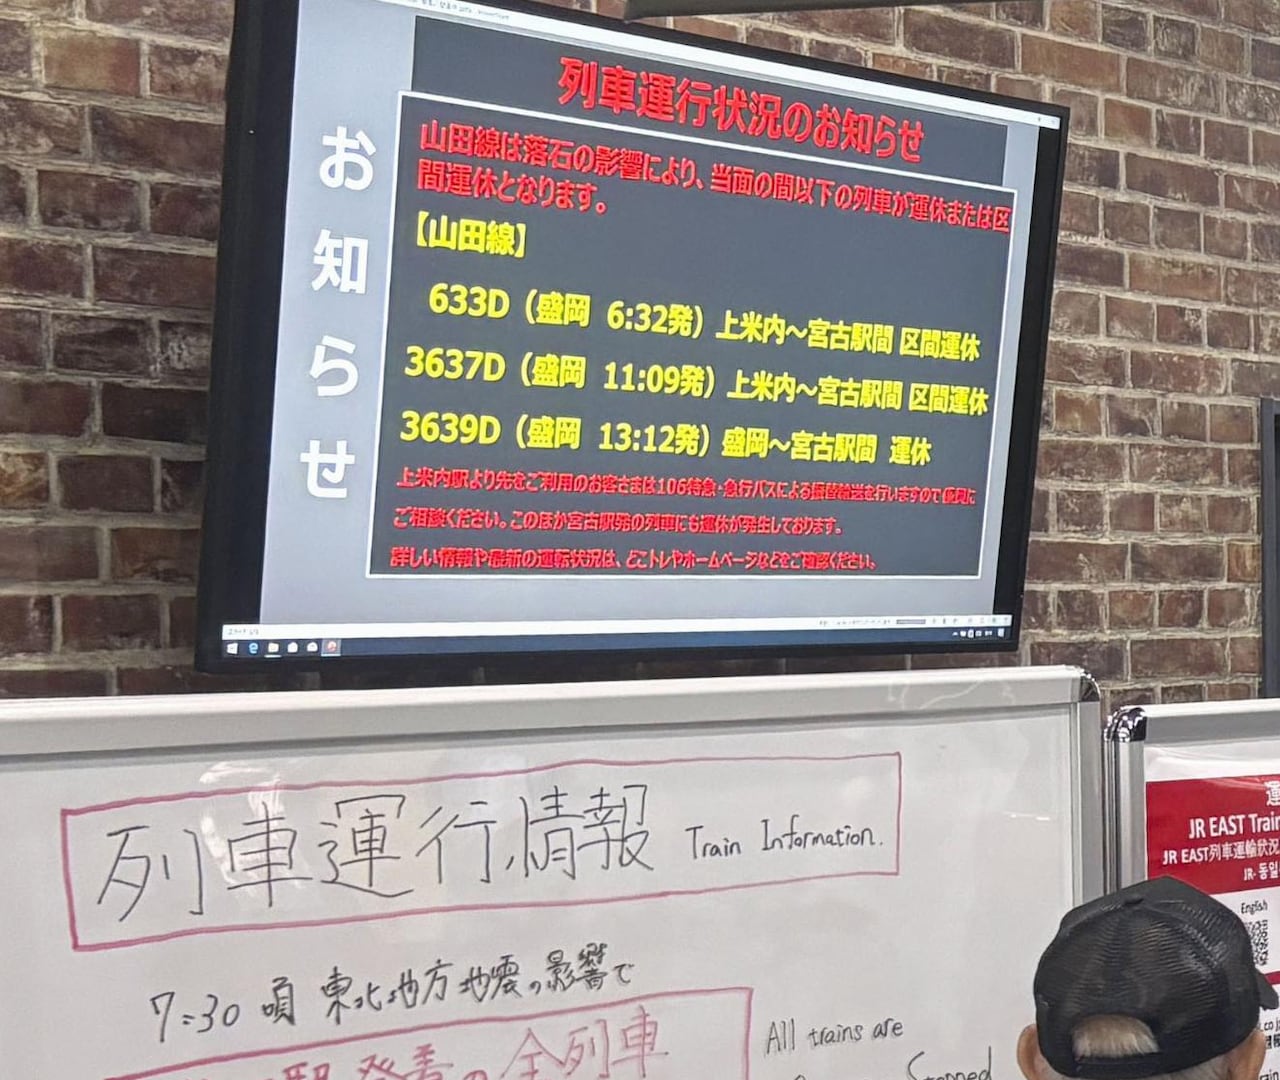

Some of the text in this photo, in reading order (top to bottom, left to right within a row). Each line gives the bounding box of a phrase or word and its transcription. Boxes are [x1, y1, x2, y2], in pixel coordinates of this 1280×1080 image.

[558, 57, 924, 162] 列車運行状況のお知らせ
[417, 160, 607, 213] 間運休となります。
[420, 120, 1010, 233] 山田線は落石の影響により、当面の間以下の列車が運休または区
[416, 211, 526, 258] 【山田線】
[300, 126, 376, 498] お知らせ
[429, 283, 509, 318] 633D
[900, 327, 981, 361] 区間運休
[404, 346, 507, 381] 3637D
[909, 386, 989, 416] 区間運休
[400, 410, 501, 444] 3639D
[890, 436, 933, 466] 運休
[98, 784, 654, 922] 列車運行情報
[685, 826, 742, 860] Train
[1188, 819, 1206, 839] JR
[1209, 815, 1245, 836] EAST
[1162, 849, 1178, 866] JR
[1241, 899, 1268, 916] English
[767, 1018, 904, 1054] All trains are
